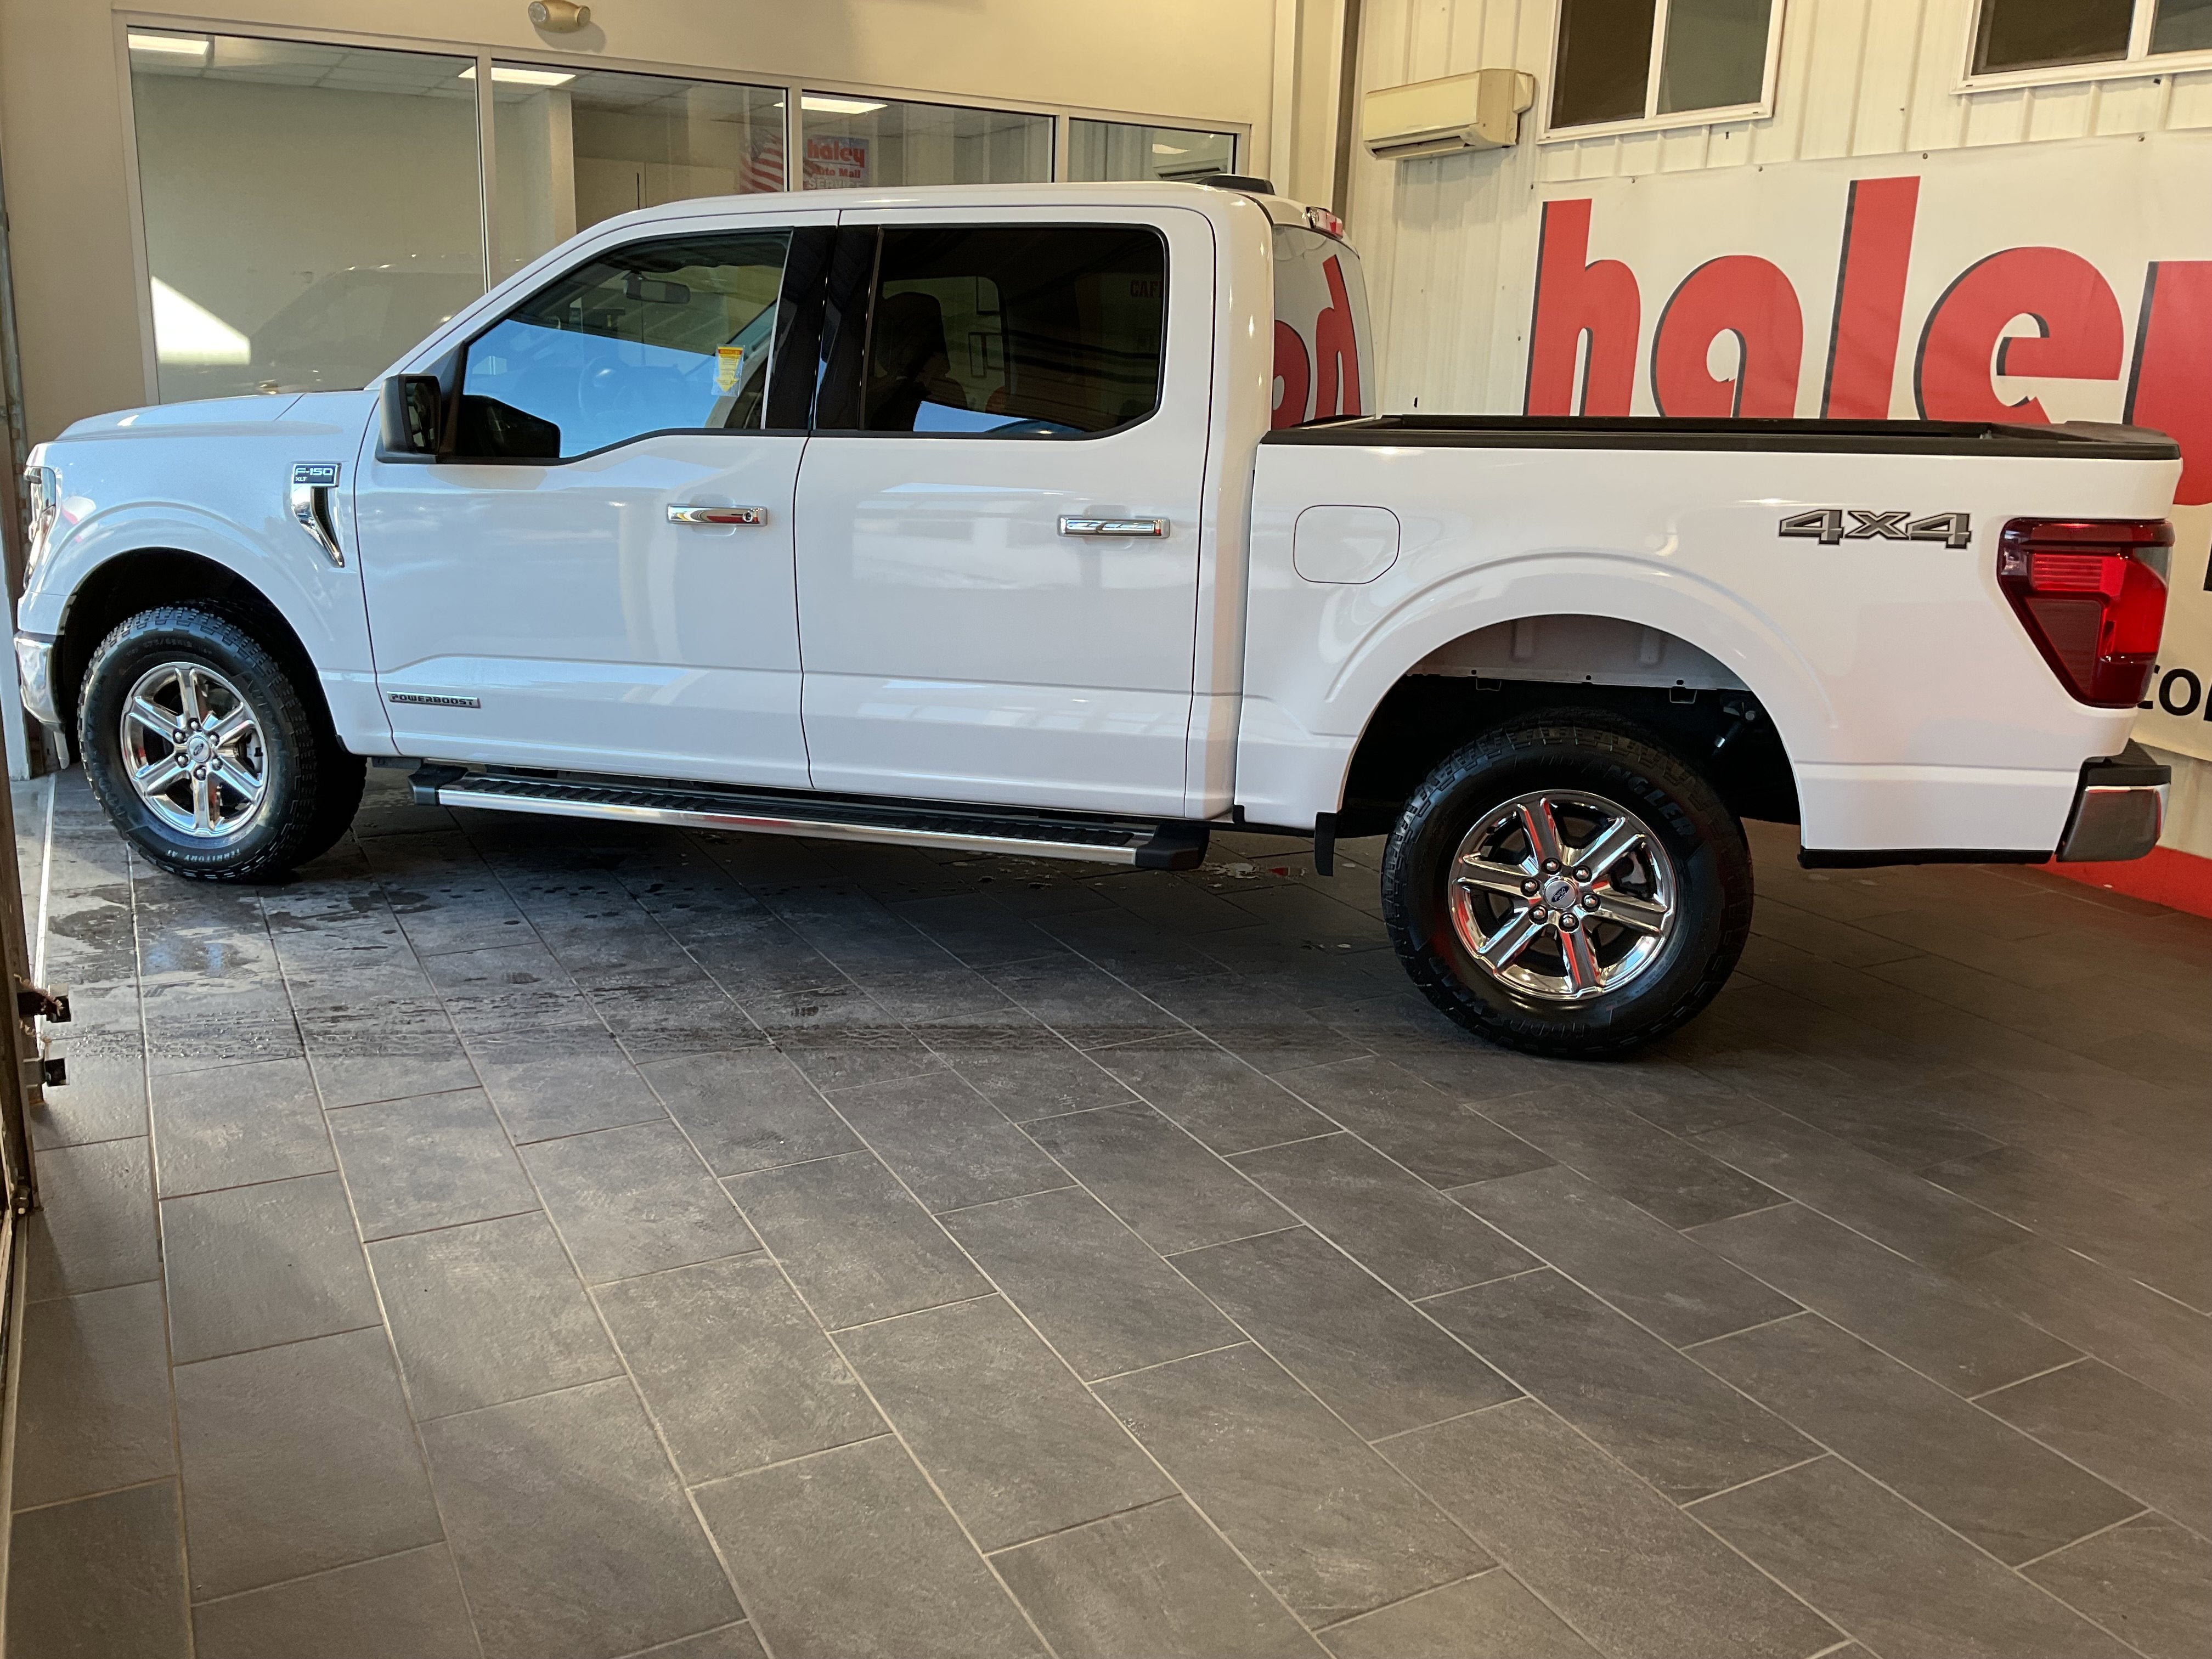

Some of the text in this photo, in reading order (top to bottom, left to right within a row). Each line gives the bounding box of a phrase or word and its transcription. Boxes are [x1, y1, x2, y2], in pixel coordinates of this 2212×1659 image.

[807, 138, 865, 168] haley
[295, 467, 333, 476] F-150
[391, 693, 473, 706] POWERBOOST
[1552, 887, 1569, 902] Ford
